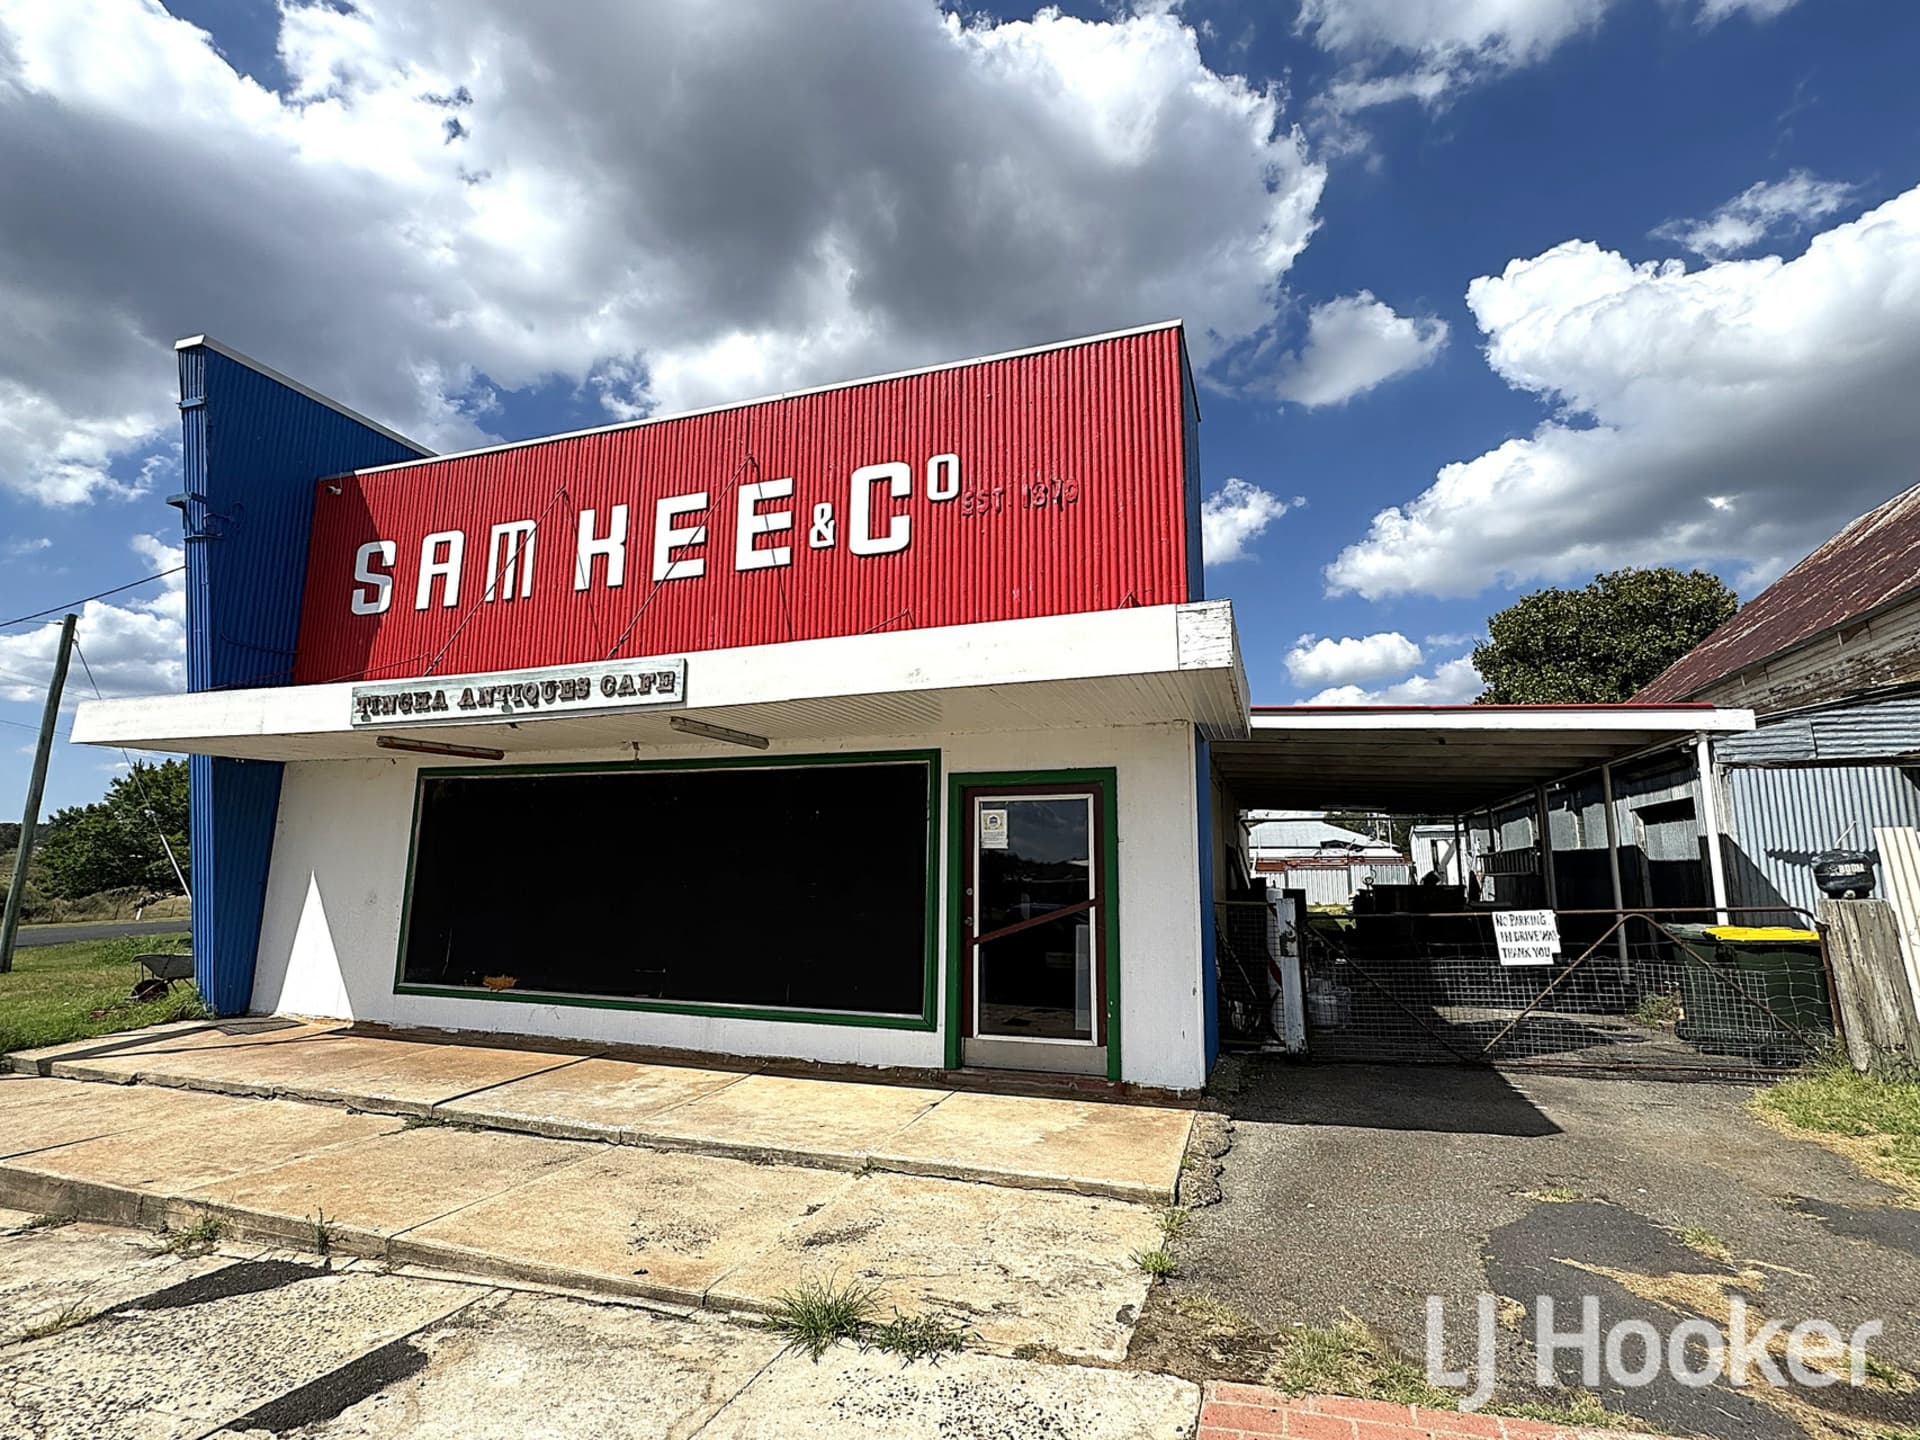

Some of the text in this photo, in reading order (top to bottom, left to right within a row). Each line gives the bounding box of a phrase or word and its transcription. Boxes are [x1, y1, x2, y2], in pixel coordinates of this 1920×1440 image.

[351, 519, 537, 615] SAM
[574, 476, 793, 593] KEE
[809, 502, 836, 549] &
[355, 671, 676, 722] TINGHA ANTIQUES CAFE
[1496, 914, 1508, 927] NO
[1532, 946, 1550, 958] YOU
